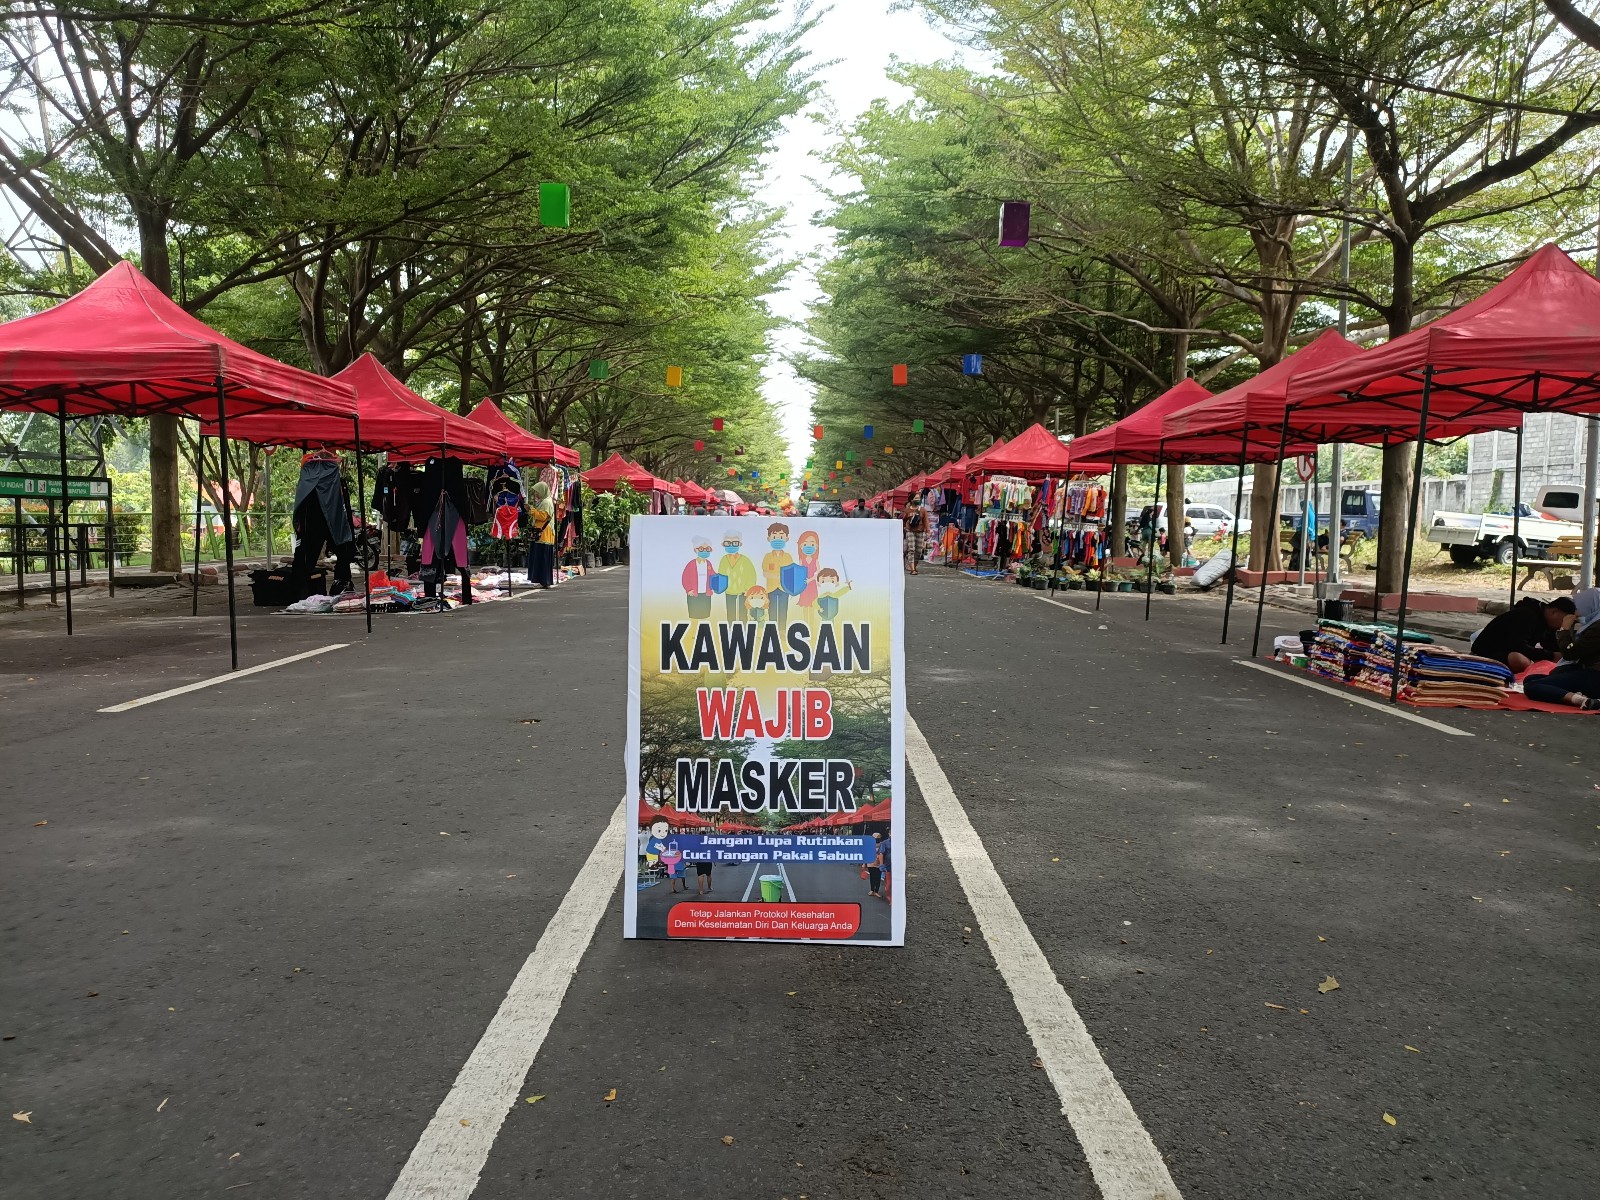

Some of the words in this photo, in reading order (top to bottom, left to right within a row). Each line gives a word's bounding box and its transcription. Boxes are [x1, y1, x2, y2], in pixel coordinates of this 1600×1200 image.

[660, 620, 871, 673] KAWASAN
[698, 688, 833, 740] WAJIB
[676, 758, 857, 812] MASKER
[700, 836, 754, 848] Jangan
[758, 836, 792, 848] Lupa
[797, 836, 863, 846] Rutinkan
[682, 849, 712, 861] Cuci
[716, 849, 769, 862] Tangan
[773, 850, 814, 861] Pakai
[818, 850, 864, 861] Sabun
[690, 909, 713, 919] Tetap
[714, 909, 752, 919] Jalankan
[754, 910, 788, 919] Protokol
[790, 910, 835, 919] Kesehatan
[674, 919, 696, 928] Demi
[698, 919, 753, 929] Keselamatan
[755, 920, 769, 929] Diri
[771, 920, 789, 929] Dan
[791, 921, 829, 932] Keluarga
[830, 921, 853, 931] Anda
